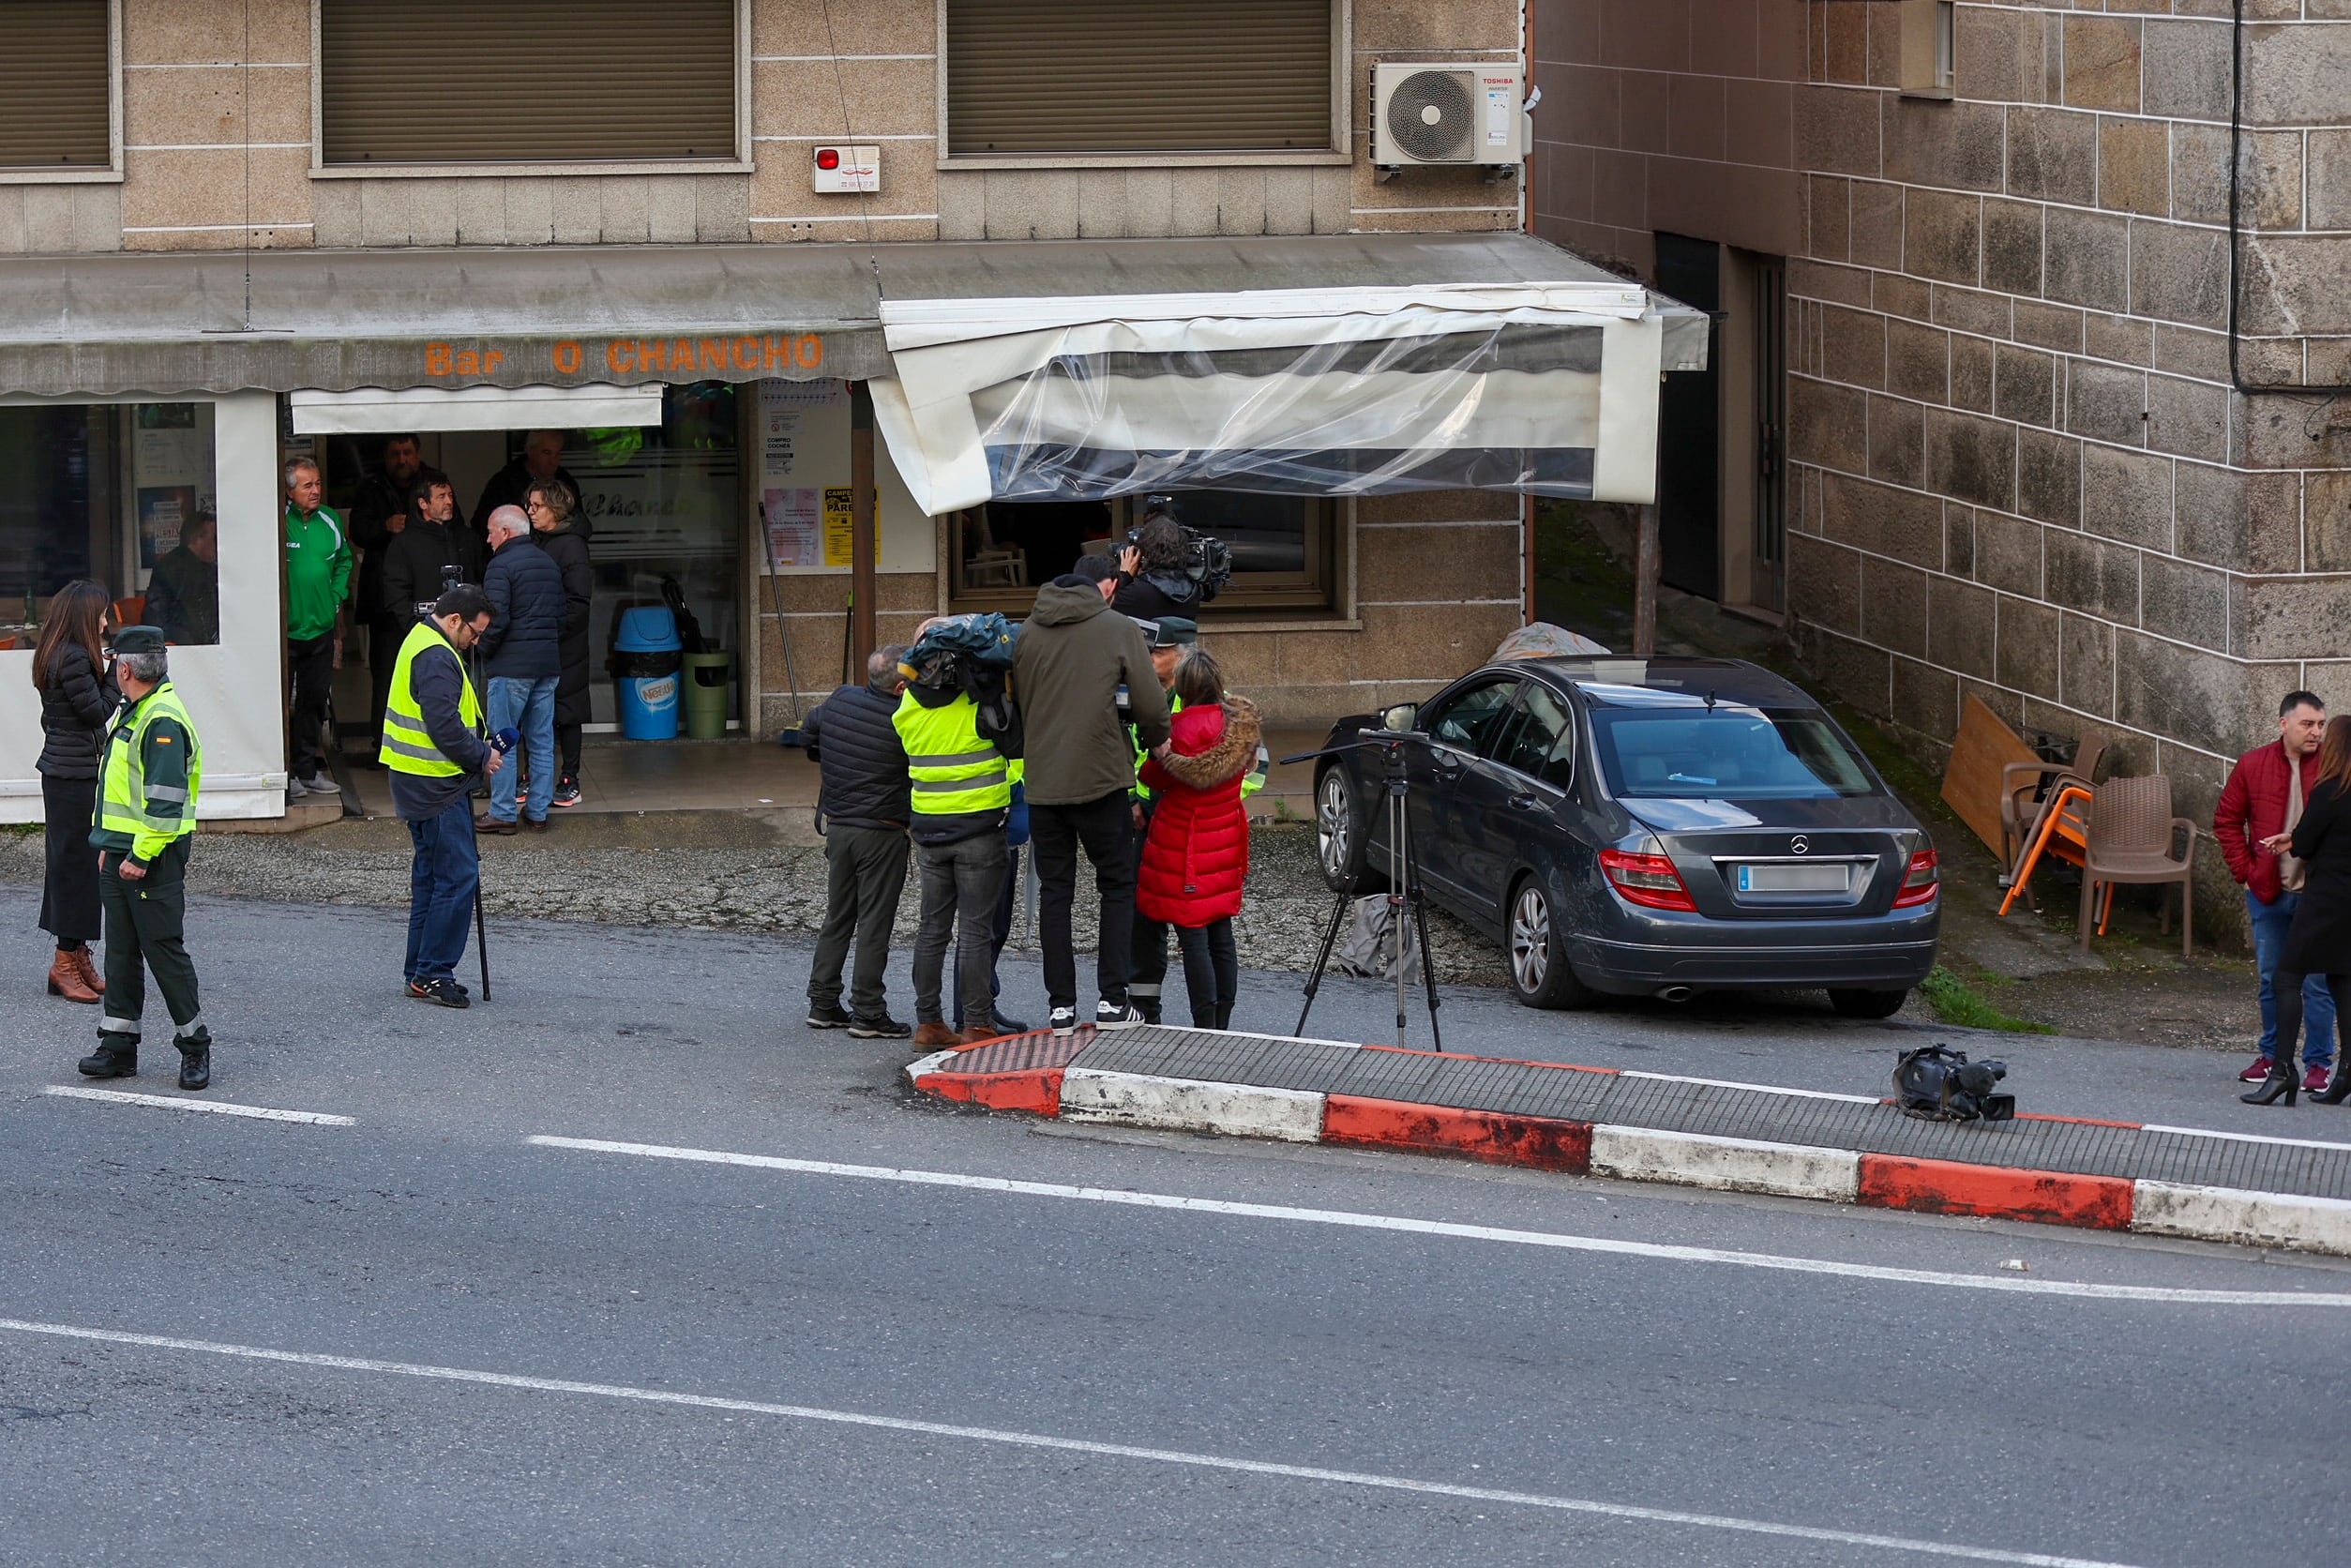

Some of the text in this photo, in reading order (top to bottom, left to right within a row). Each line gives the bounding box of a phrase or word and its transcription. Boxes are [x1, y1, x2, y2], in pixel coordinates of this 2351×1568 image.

[425, 334, 824, 375] Bar O CHANCHO
